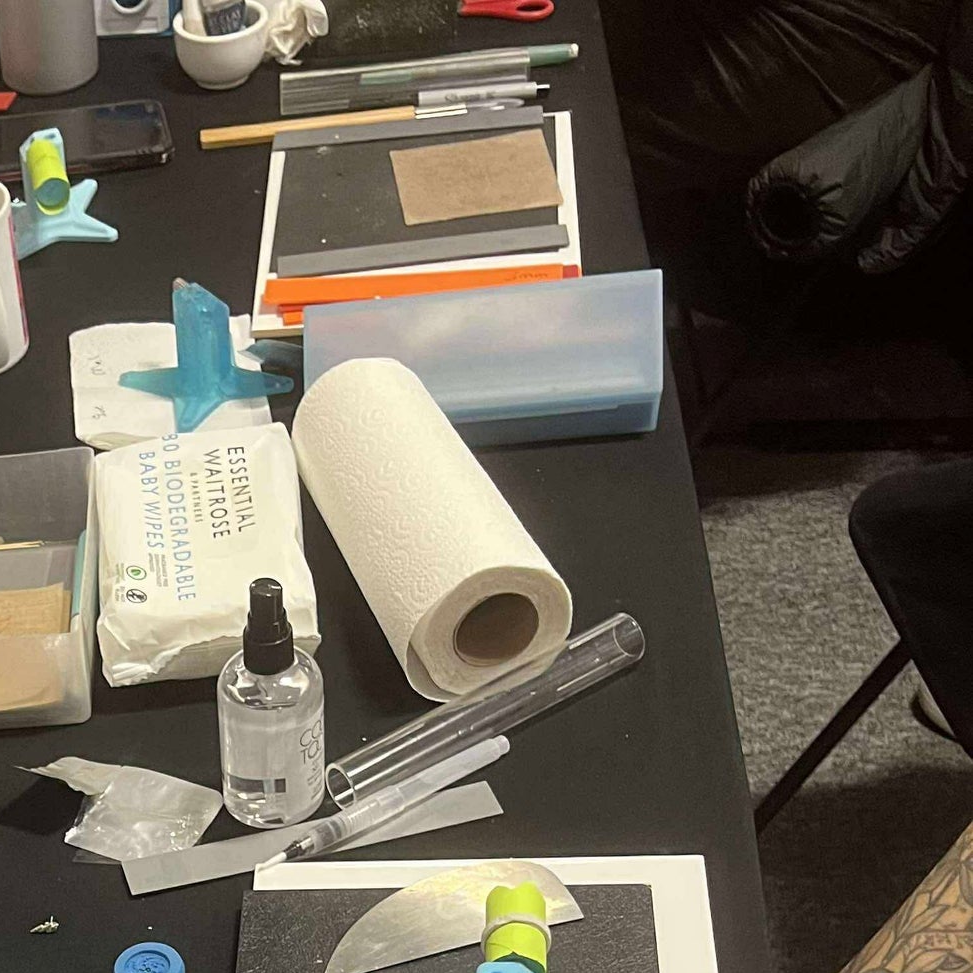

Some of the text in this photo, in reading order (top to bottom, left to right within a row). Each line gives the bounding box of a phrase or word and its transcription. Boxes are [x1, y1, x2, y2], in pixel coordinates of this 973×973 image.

[139, 451, 165, 549] BABY WIPES
[164, 460, 196, 601] BIODEGRADABLE
[191, 480, 203, 523] PARTNERS
[204, 448, 231, 539] WAITROSE
[227, 447, 256, 533] ESSENTIAL
[300, 720, 323, 747] CO
